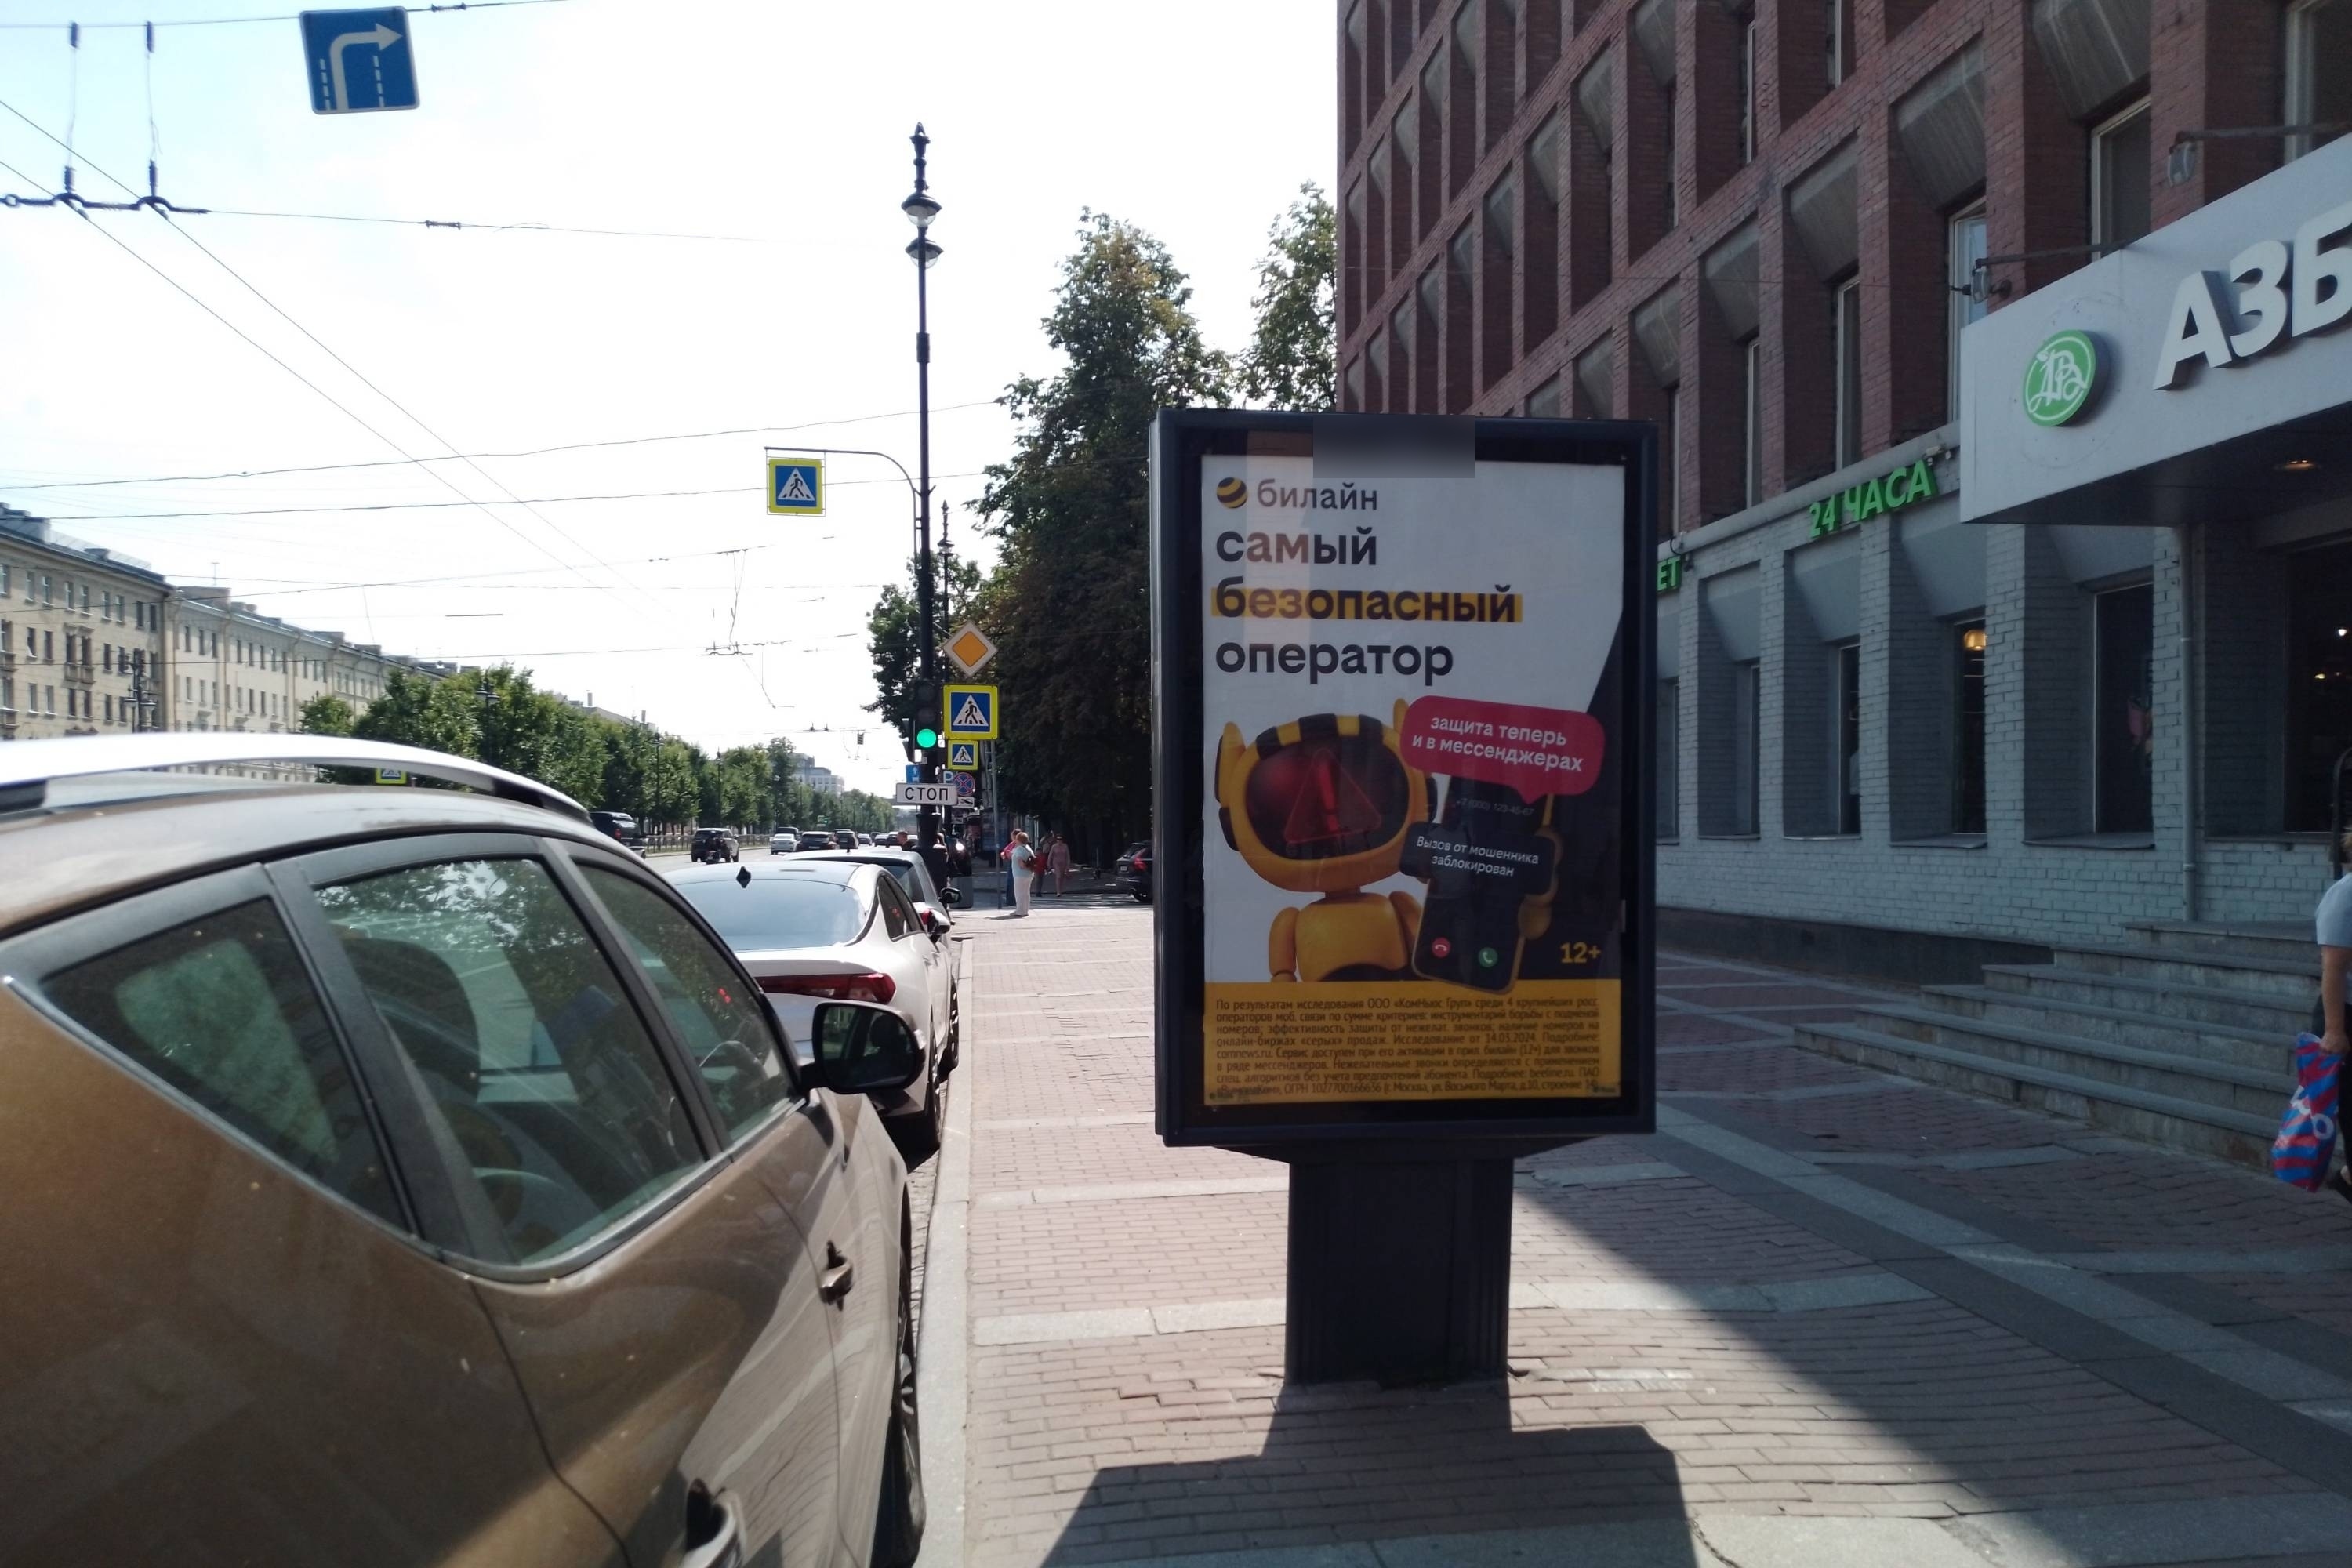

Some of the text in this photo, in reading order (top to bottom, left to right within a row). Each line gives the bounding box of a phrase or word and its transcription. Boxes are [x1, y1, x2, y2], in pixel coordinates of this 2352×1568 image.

[2154, 202, 2352, 391] АЗБ
[1257, 478, 1377, 510] билайн
[1809, 460, 1936, 539] 24 ЧАСА
[1216, 526, 1377, 565] самый
[1216, 576, 1515, 622] безопасный
[1216, 641, 1454, 687] оператор
[1430, 717, 1567, 749] защита теперь
[1412, 735, 1584, 772] и в мессенджерах
[905, 786, 948, 801] СТОП
[1416, 835, 1540, 865] Вызов от мошенника
[1431, 855, 1515, 877] заблокирован
[1560, 942, 1602, 964] 12+
[1216, 1000, 1229, 1010] По
[1233, 1001, 1292, 1011] результатам
[1367, 997, 1390, 1008] ООО
[1216, 1014, 1272, 1024] операторов
[1344, 1012, 1373, 1022] сумме
[1269, 1022, 1345, 1036] эффективность
[1348, 1024, 1387, 1033] защиты
[1216, 1035, 1295, 1048] онлайн-биржах
[1393, 1033, 1465, 1045] Исследование
[1276, 1047, 1308, 1060] Сервис
[1312, 1048, 1355, 1059] доступен
[1358, 1048, 1375, 1058] при
[1226, 1062, 1250, 1073] ряде
[1333, 1057, 1410, 1069] Нежелательные
[1415, 1058, 1448, 1067] звонки
[1244, 1073, 1300, 1084] алгоритмов
[1303, 1070, 1319, 1081] без
[1578, 1066, 1600, 1076] ПАО
[1284, 1083, 1308, 1093] ОГРН
